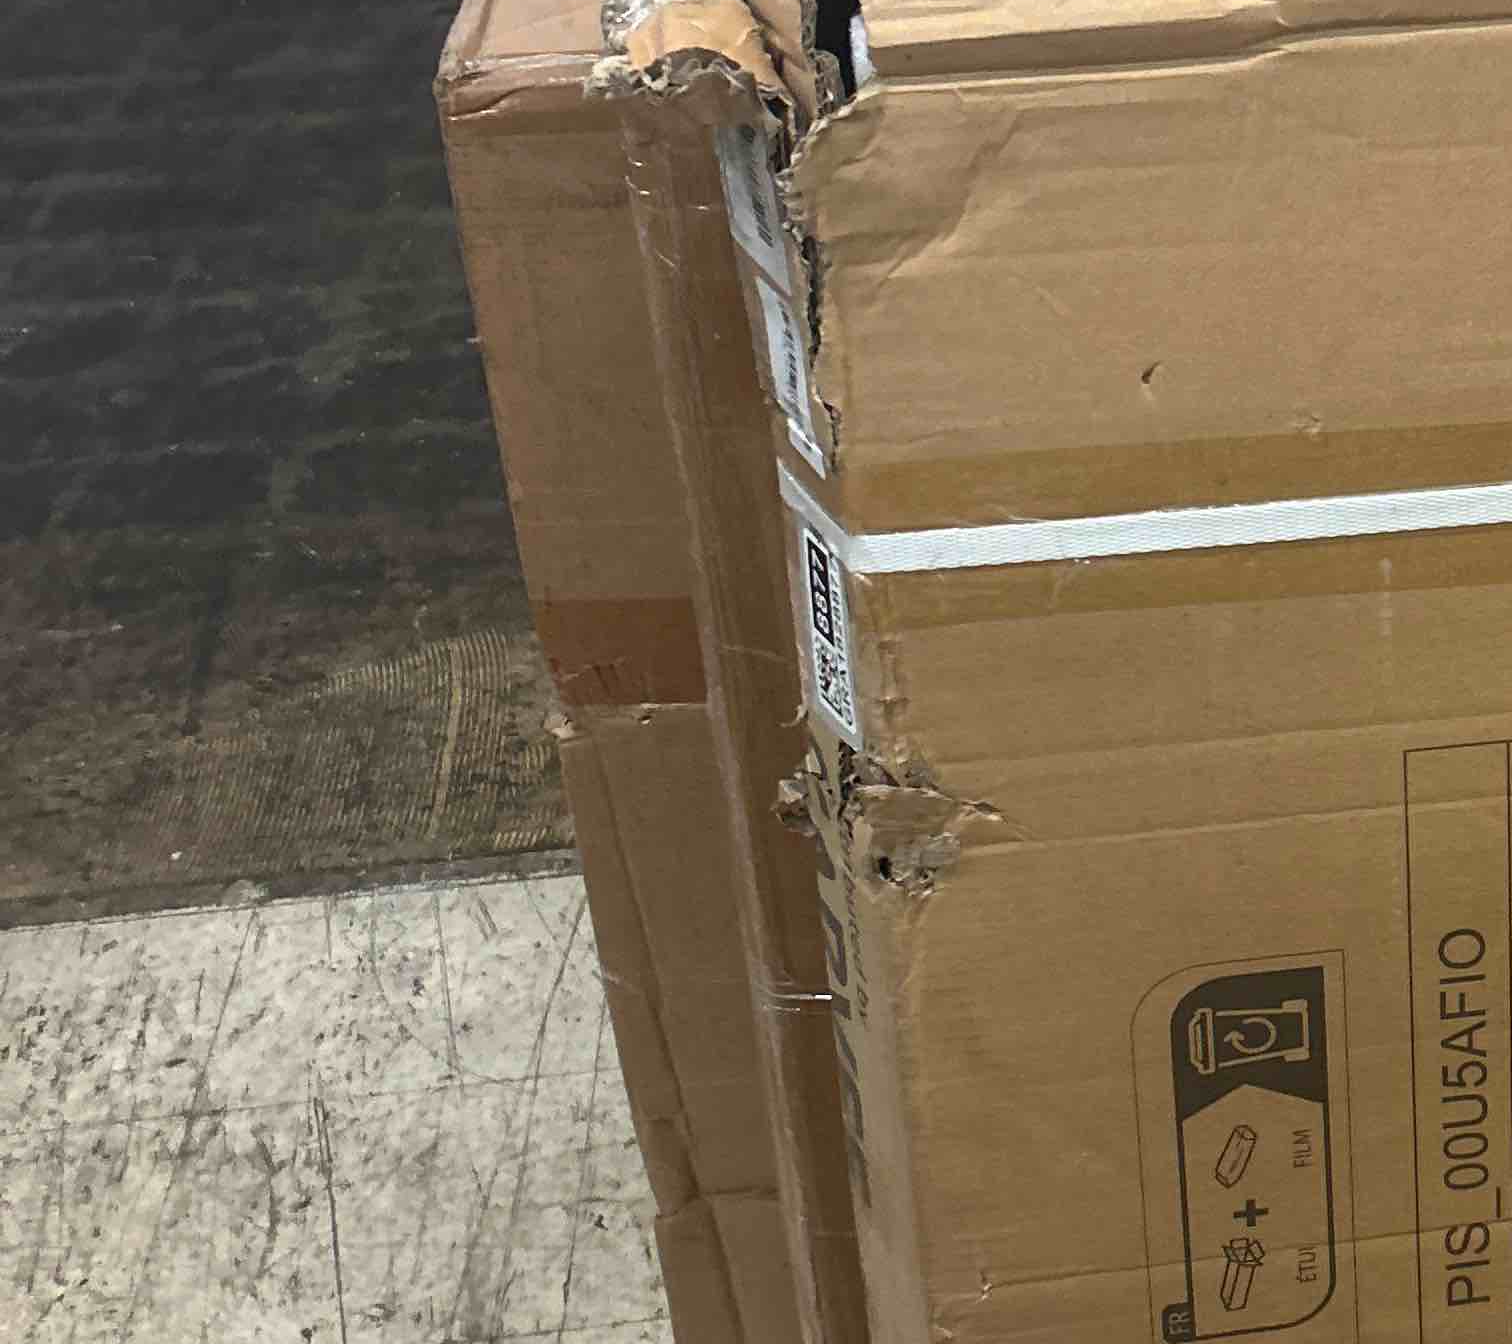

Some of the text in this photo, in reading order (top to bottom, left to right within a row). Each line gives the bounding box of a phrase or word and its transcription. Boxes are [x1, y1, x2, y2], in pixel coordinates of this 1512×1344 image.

[811, 548, 831, 635] 8877
[1292, 1129, 1313, 1168] FILM
[1296, 1247, 1317, 1283] ÉTUI
[1167, 1311, 1190, 1335] FR
